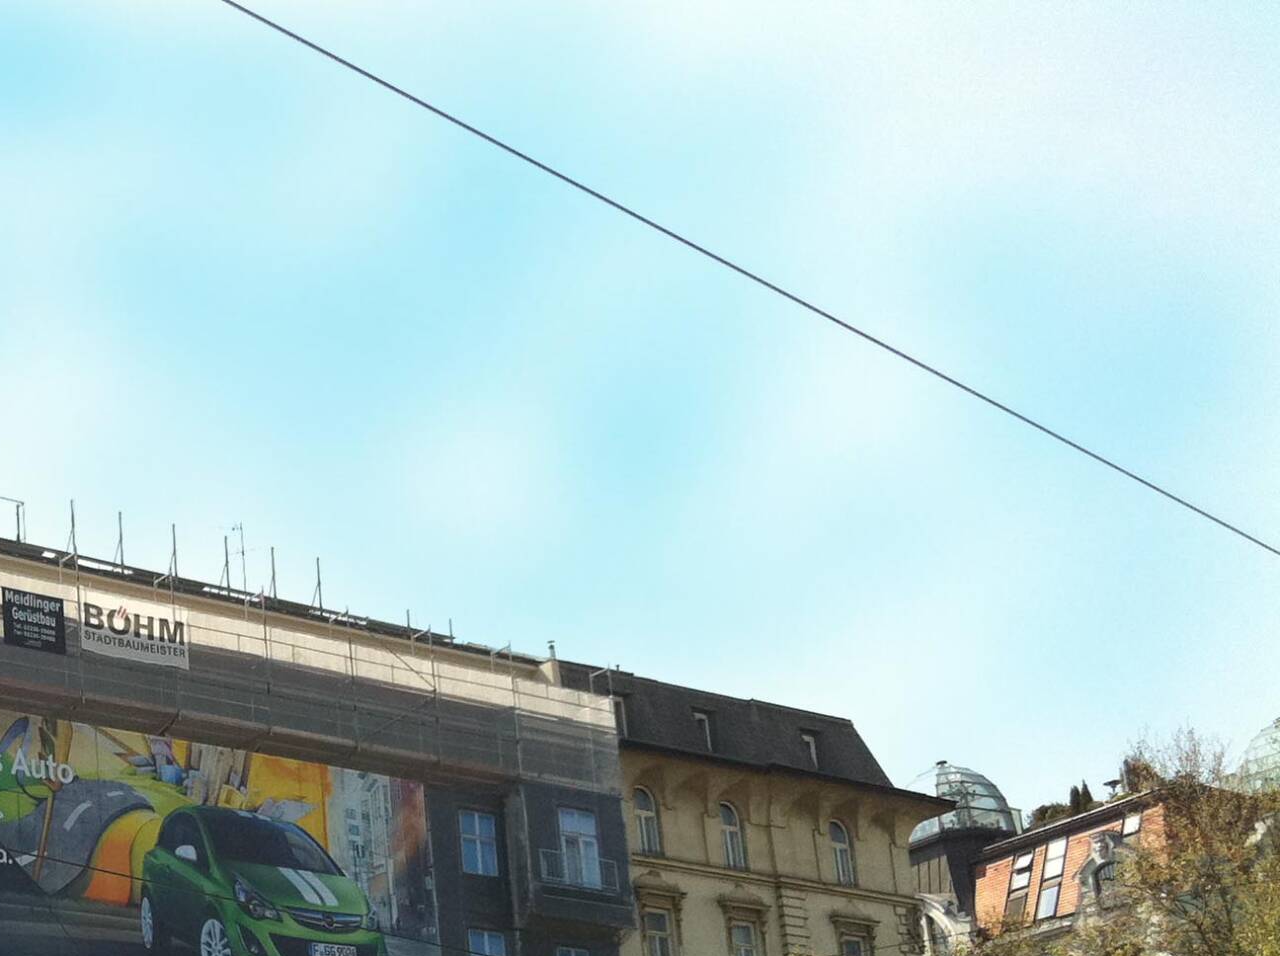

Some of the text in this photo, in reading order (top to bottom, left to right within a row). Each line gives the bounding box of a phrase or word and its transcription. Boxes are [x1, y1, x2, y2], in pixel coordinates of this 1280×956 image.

[5, 590, 60, 612] Meidlinger
[12, 606, 56, 627] Gerüstbau
[84, 602, 185, 646] BÖHM
[84, 629, 186, 659] STADTBAUMEISTER
[11, 748, 74, 784] Auto
